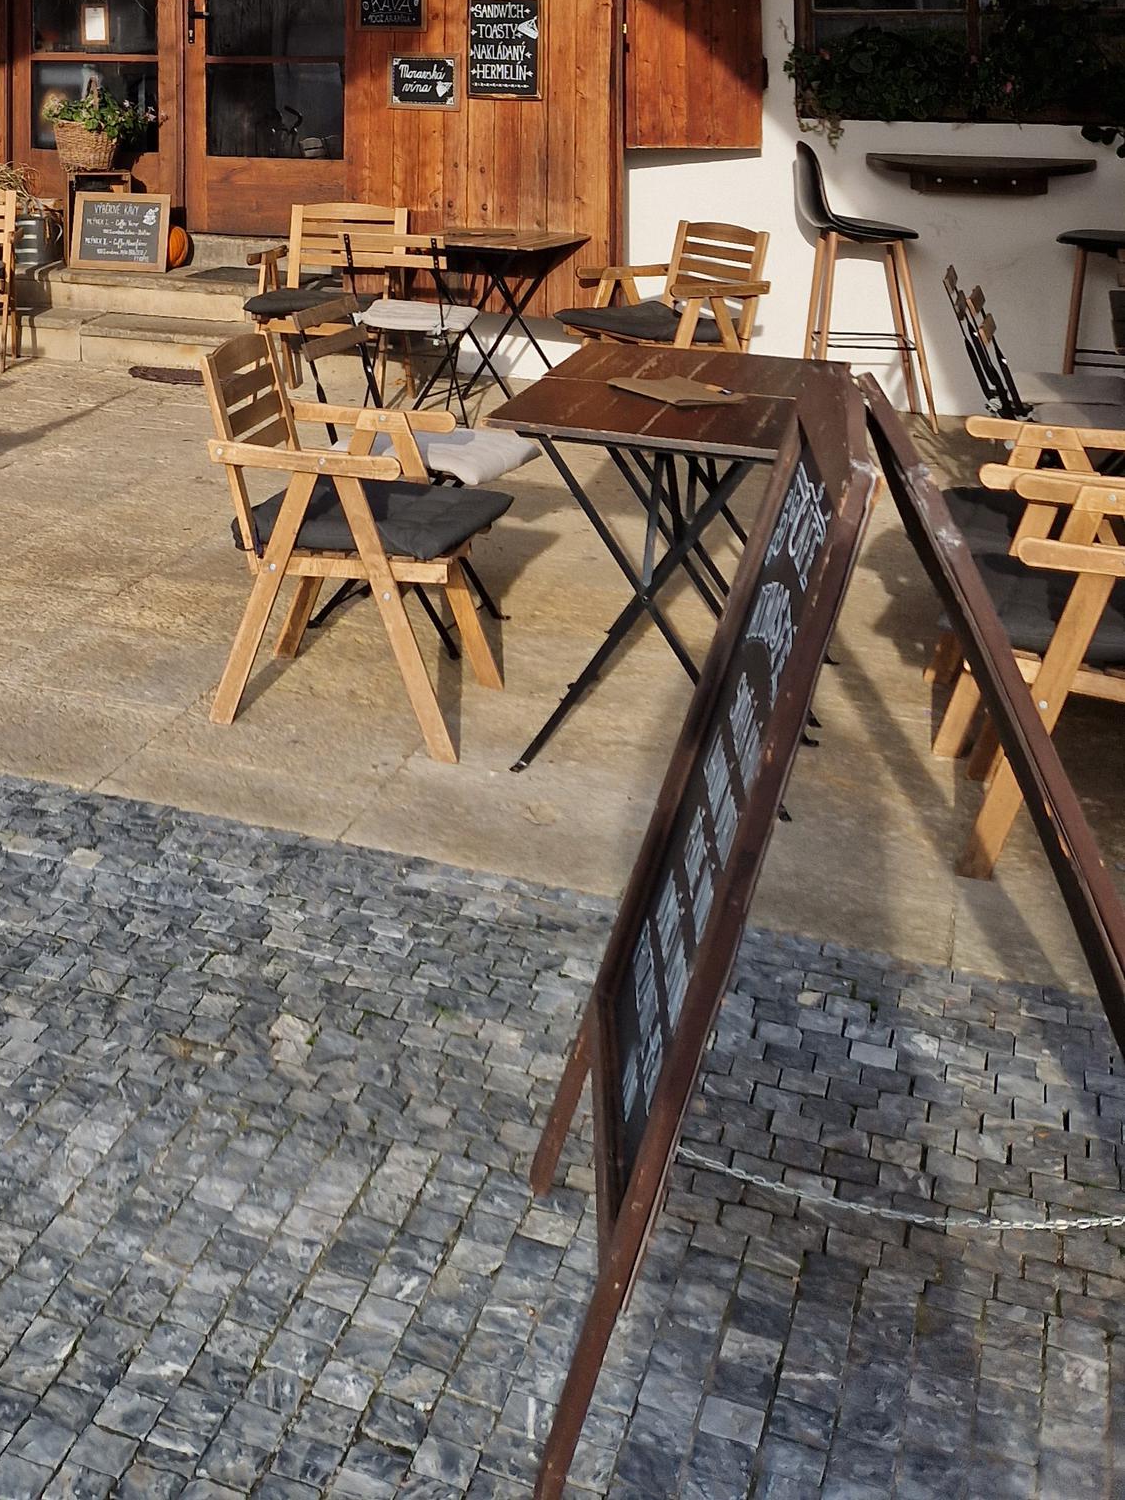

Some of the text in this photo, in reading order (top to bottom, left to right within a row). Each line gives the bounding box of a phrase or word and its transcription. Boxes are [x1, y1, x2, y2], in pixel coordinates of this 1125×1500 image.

[476, 23, 517, 40] TOASTY
[473, 41, 526, 61] NAKLÁDANÝ
[398, 63, 446, 80] Moravská
[476, 60, 527, 81] HERMELÍN
[401, 80, 432, 93] vína
